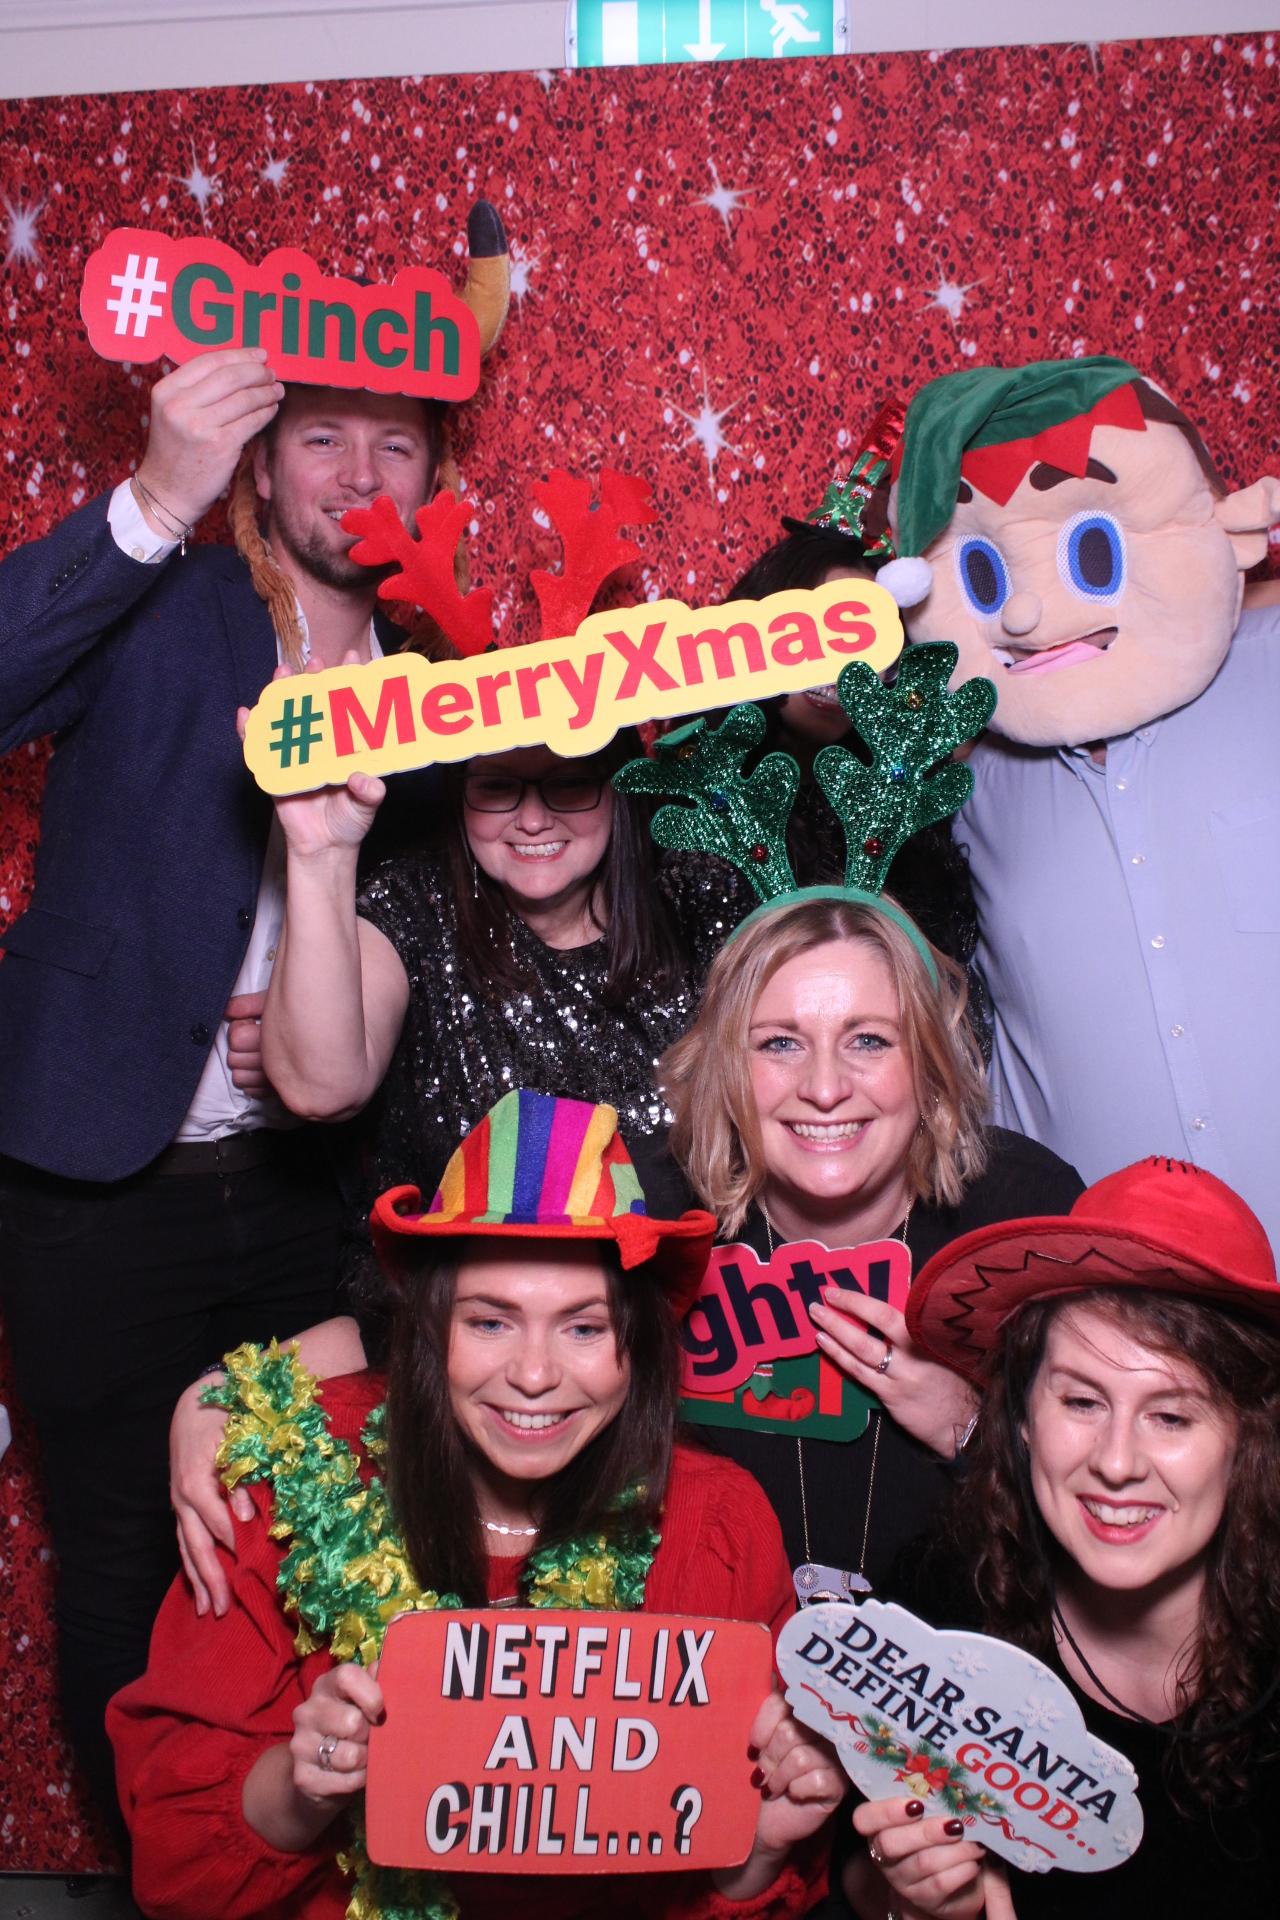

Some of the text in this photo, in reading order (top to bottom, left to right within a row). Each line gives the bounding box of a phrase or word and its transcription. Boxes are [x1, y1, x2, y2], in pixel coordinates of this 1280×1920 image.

[107, 253, 460, 376] #Grinch
[269, 600, 877, 769] #MerryXmas
[441, 1621, 716, 1705] NETFLIX
[795, 1633, 958, 1750] DEFINE
[835, 1617, 1117, 1823] DEAR SANTA
[484, 1715, 660, 1772] AND
